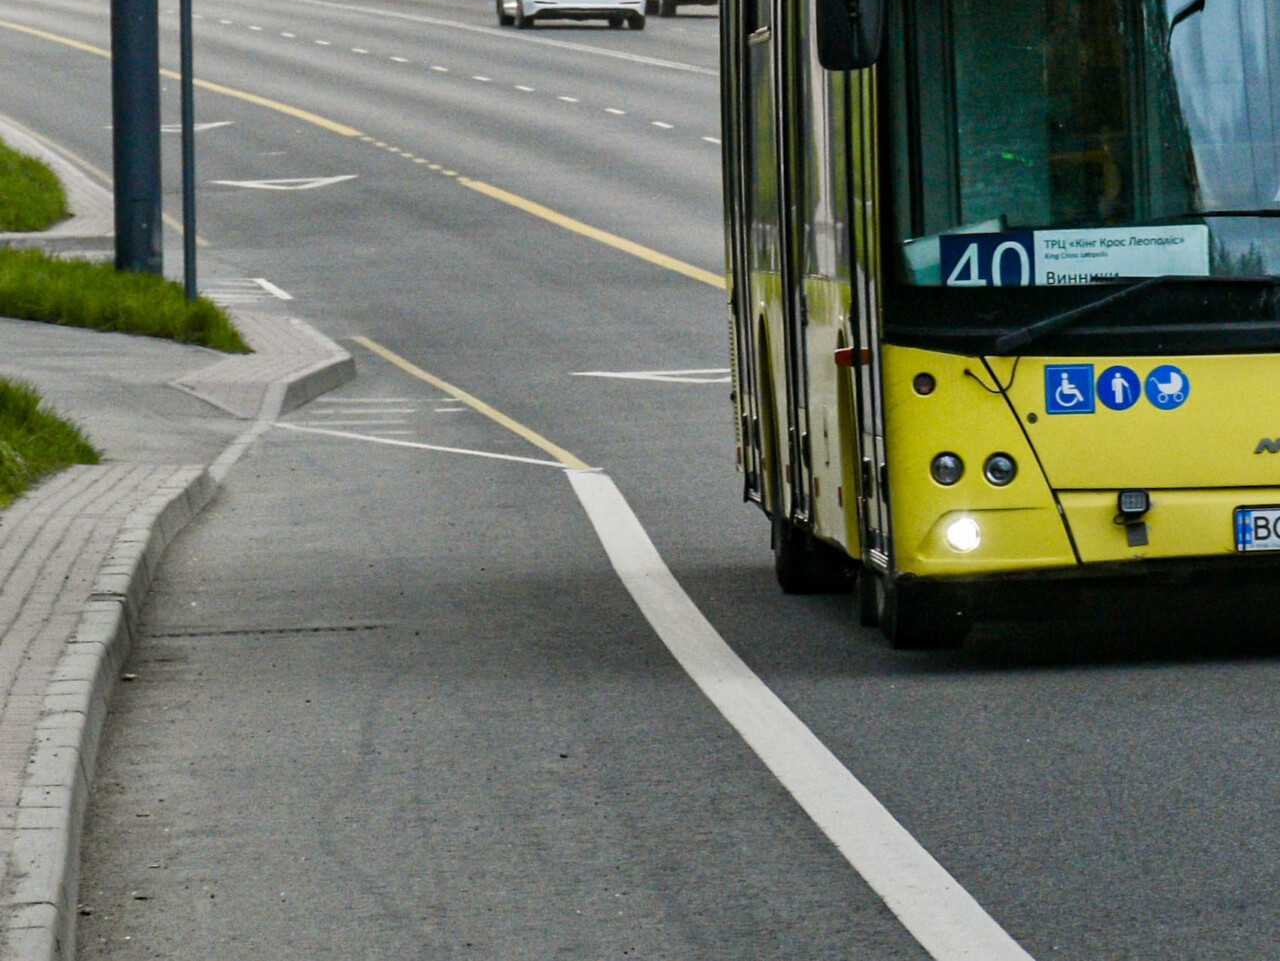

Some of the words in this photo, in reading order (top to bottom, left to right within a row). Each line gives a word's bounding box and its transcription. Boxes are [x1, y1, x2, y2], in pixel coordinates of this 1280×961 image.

[1044, 239, 1066, 250] ТРЦ
[1099, 238, 1126, 248] Крос
[946, 241, 1030, 286] 40
